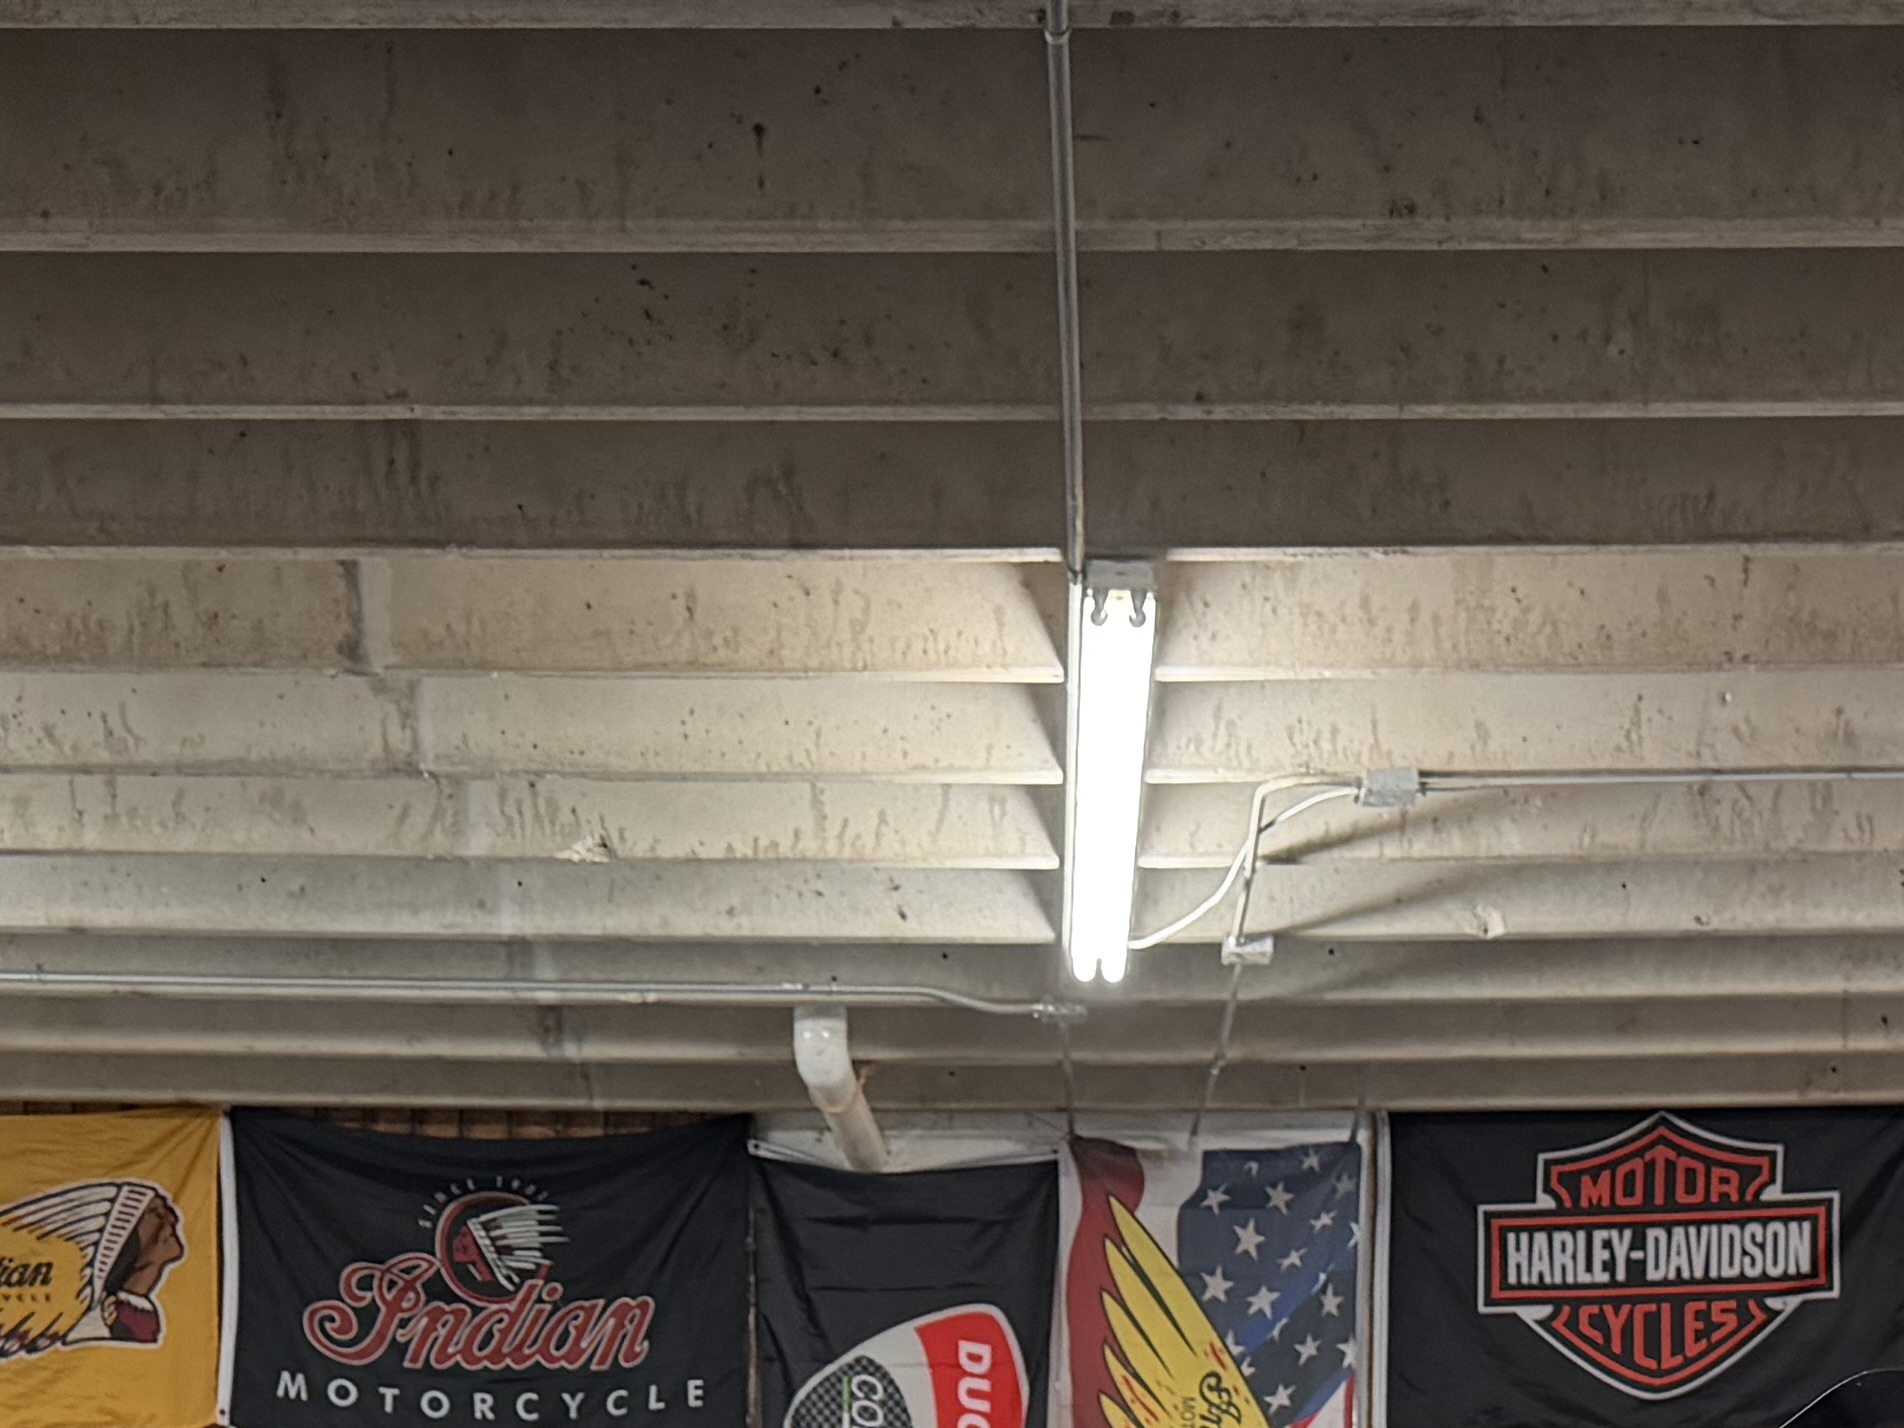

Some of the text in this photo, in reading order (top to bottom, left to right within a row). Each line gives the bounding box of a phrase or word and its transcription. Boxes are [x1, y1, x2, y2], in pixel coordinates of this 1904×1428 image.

[1580, 1144, 1741, 1208] MOTOR
[1506, 1220, 1813, 1286] HARLEY-DAVIDSON
[302, 1251, 656, 1372] Indian
[1577, 1299, 1739, 1371] CYCLES
[276, 1370, 705, 1422] MOTORCYCLE
